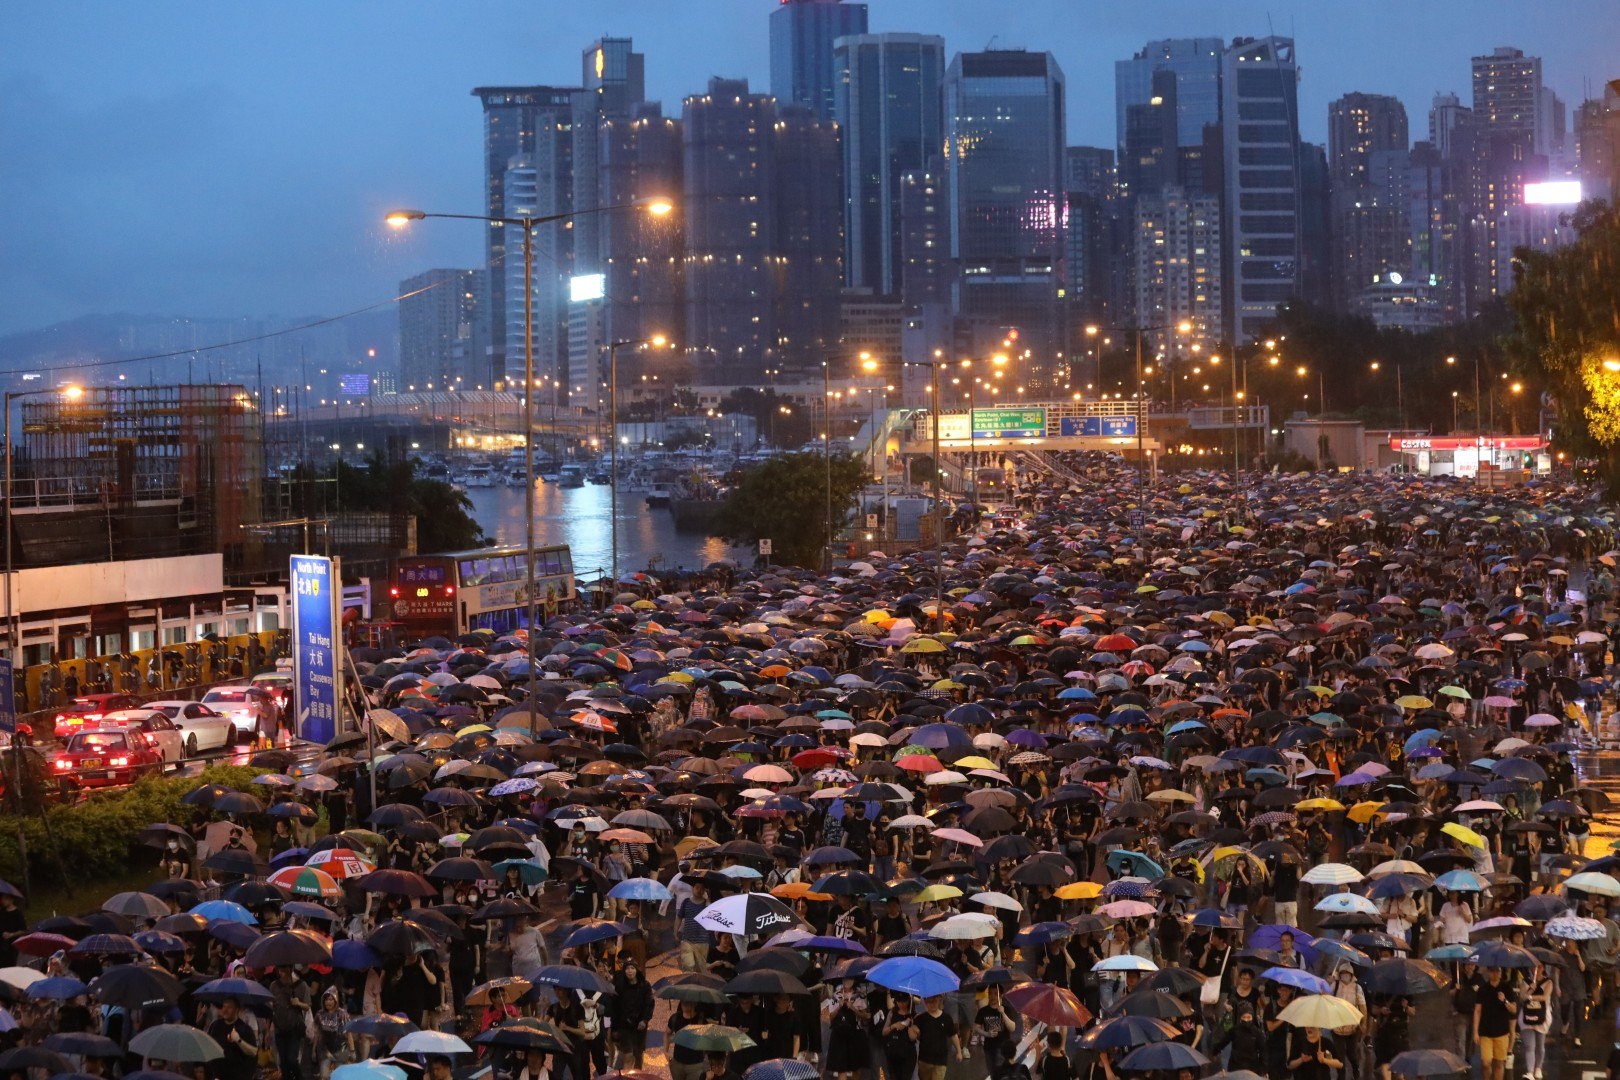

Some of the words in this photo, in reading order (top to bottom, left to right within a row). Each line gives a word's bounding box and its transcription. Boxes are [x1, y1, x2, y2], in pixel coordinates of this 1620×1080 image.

[297, 561, 312, 574] North
[313, 562, 326, 575] Point
[298, 577, 312, 595] 北角
[308, 632, 317, 644] Tai
[317, 634, 330, 648] Hang
[309, 649, 323, 666] 大坑
[310, 671, 333, 687] Causeway
[310, 685, 319, 698] Bay
[297, 886, 318, 894] 7-ELEVEN
[702, 909, 735, 928] Titleist
[756, 912, 791, 929] Titleist
[835, 926, 854, 940] UP
